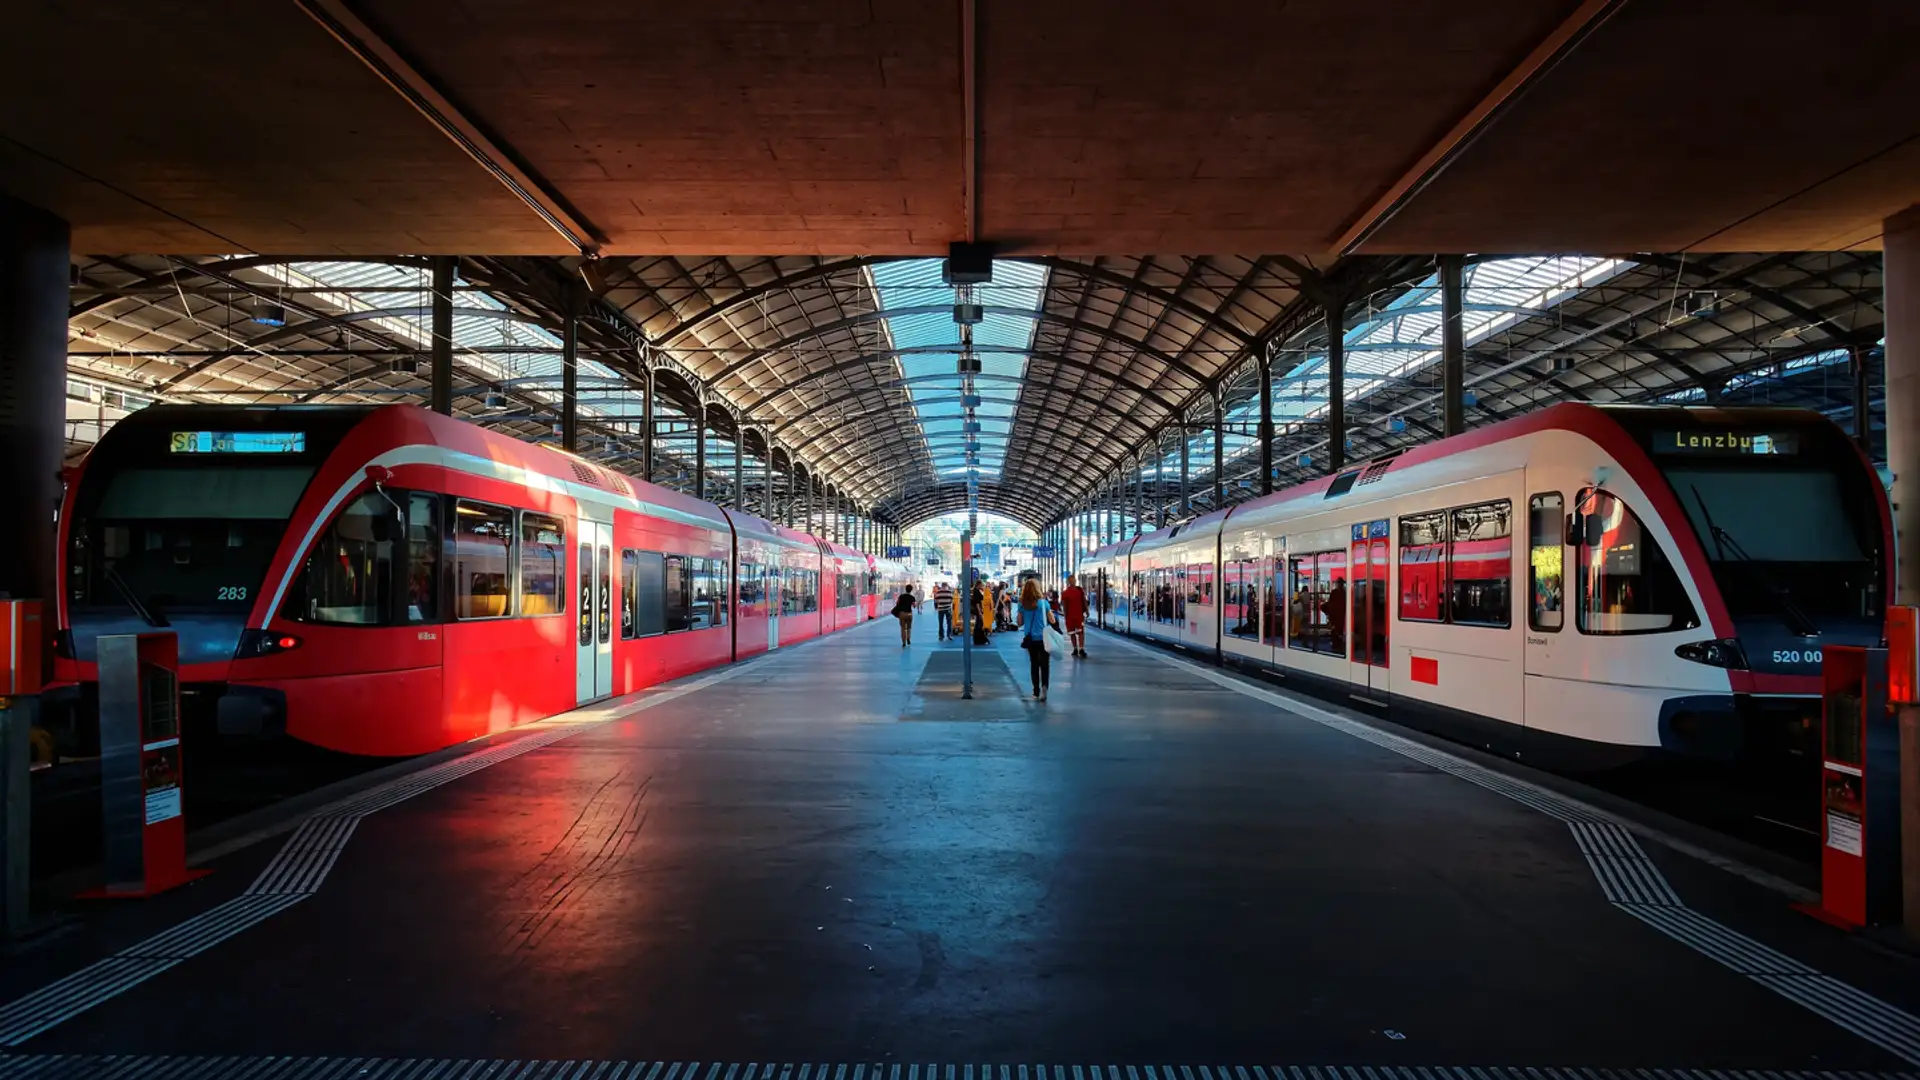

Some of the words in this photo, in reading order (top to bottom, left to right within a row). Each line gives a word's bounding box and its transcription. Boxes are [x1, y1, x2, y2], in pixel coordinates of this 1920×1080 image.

[217, 586, 247, 600] 283
[583, 587, 590, 610] 2
[601, 587, 608, 610] 2
[1773, 650, 1800, 663] 520
[1803, 650, 1823, 663] 00
